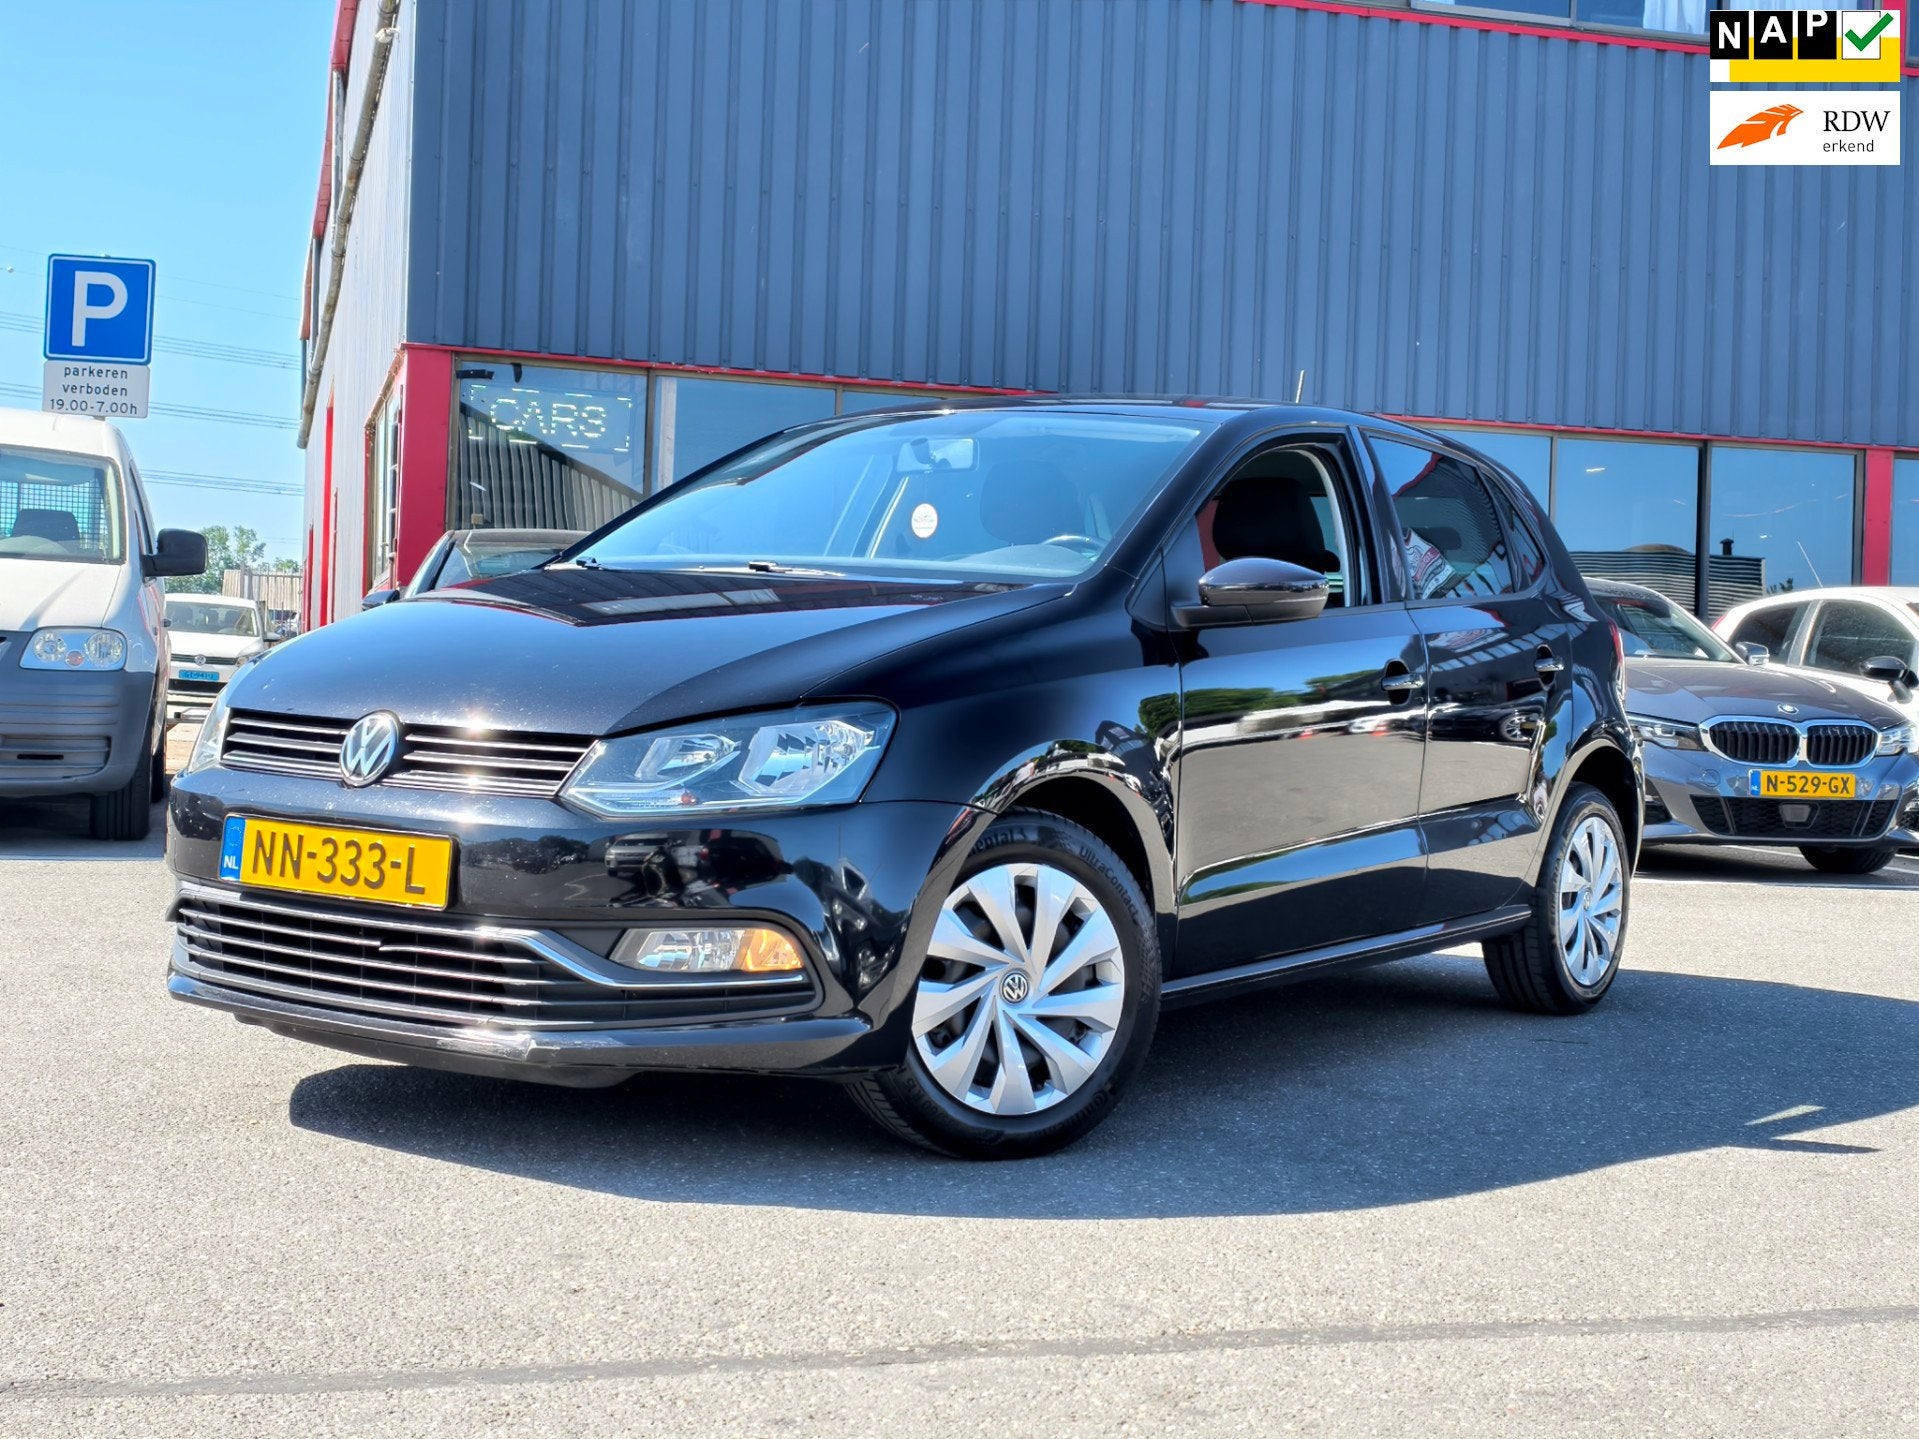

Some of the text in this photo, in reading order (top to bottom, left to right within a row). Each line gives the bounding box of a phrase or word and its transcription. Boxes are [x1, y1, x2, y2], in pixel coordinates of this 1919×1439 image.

[71, 270, 128, 347] P
[63, 366, 128, 380] parkeren
[62, 383, 128, 397] verboden
[49, 398, 138, 415] 19.00-7.00h
[489, 398, 607, 438] CARS
[1766, 774, 1851, 794] N-529-GX
[223, 855, 239, 870] NL
[252, 829, 426, 895] NN-333-L
